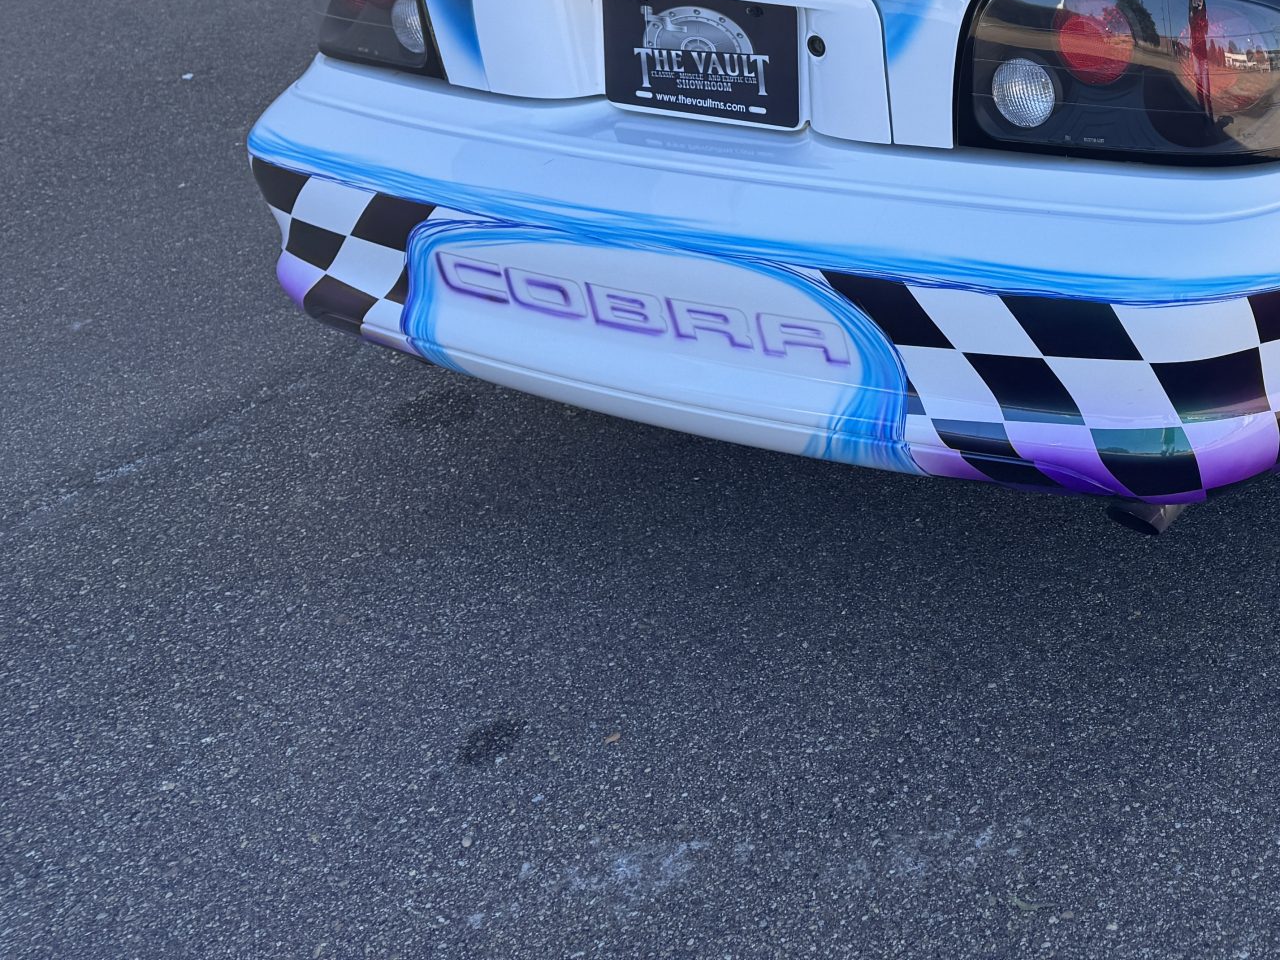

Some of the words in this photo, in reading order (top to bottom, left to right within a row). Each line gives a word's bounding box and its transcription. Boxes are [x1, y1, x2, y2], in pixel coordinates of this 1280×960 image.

[634, 48, 685, 88] THE
[691, 52, 769, 95] VAULT
[676, 79, 732, 92] SHOWROOM
[656, 92, 746, 112] www.thevaultms.com
[435, 251, 851, 367] COBRA
